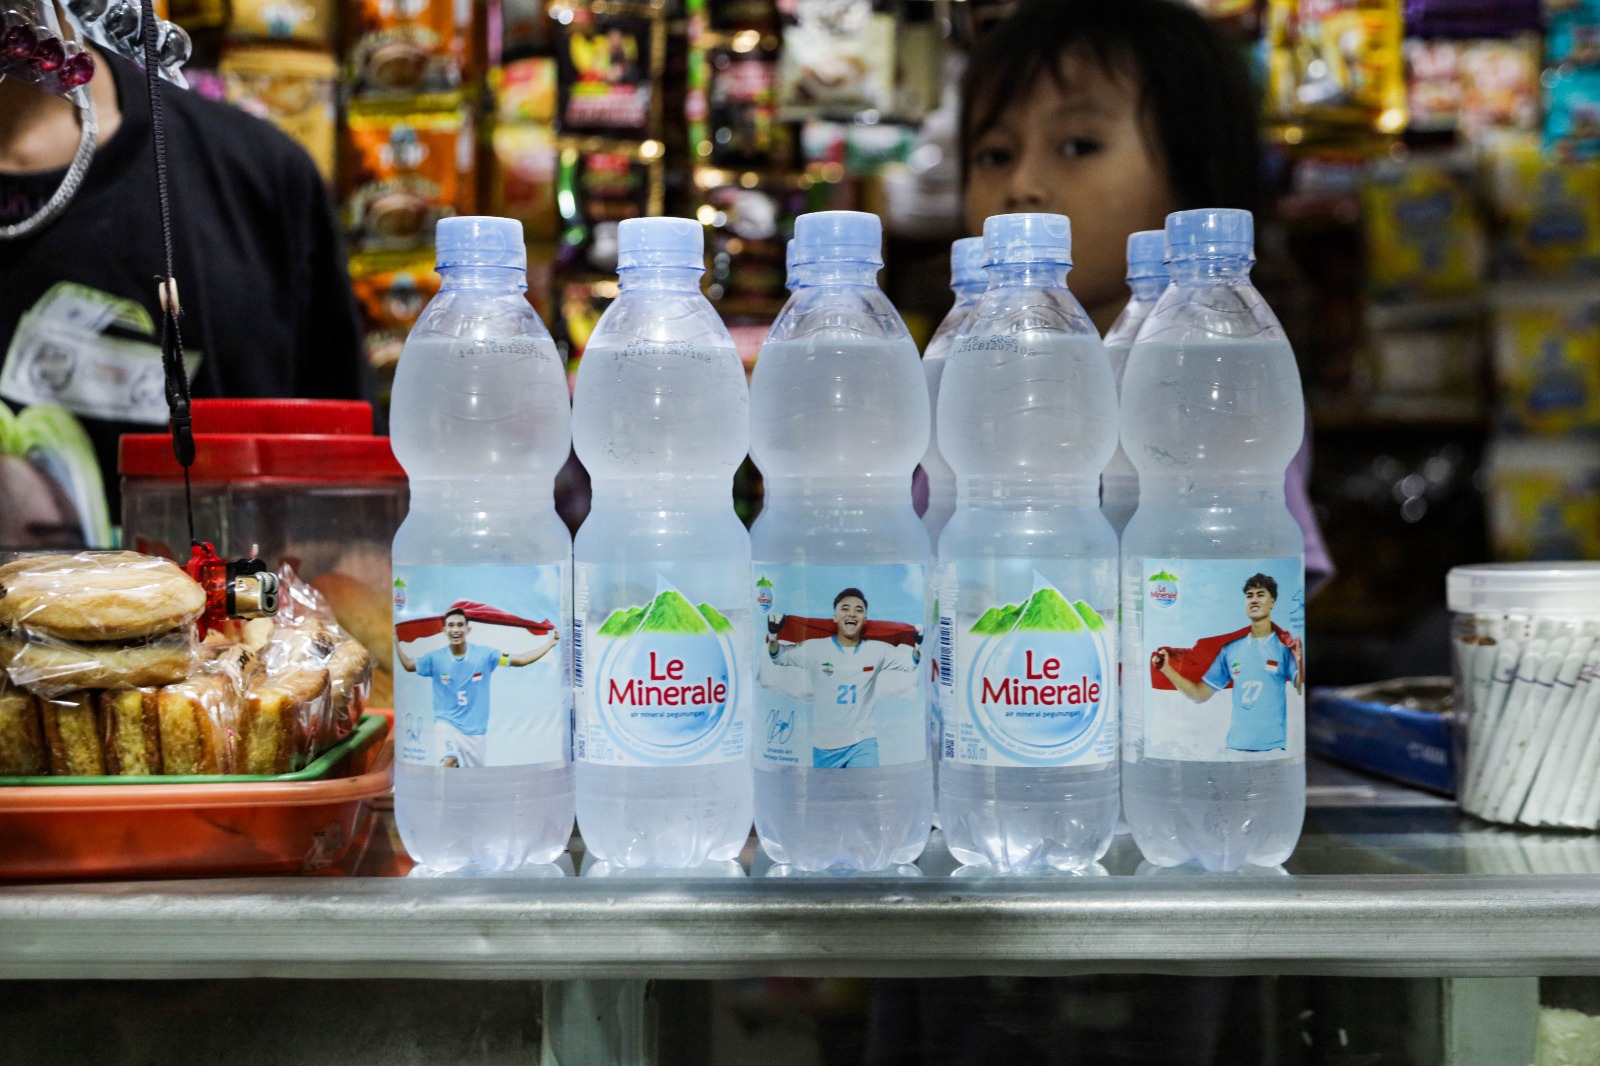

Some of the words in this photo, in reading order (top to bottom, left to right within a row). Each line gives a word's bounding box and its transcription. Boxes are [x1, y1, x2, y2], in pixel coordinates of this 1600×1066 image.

[649, 651, 685, 681] Le
[1025, 650, 1061, 680] Le
[457, 690, 468, 706] 5
[608, 676, 727, 706] Minerale
[837, 684, 856, 705] 21
[981, 676, 1100, 706] Minerale
[1241, 680, 1264, 704] 27
[666, 711, 706, 719] pegunungan
[1043, 711, 1081, 719] pegunungan
